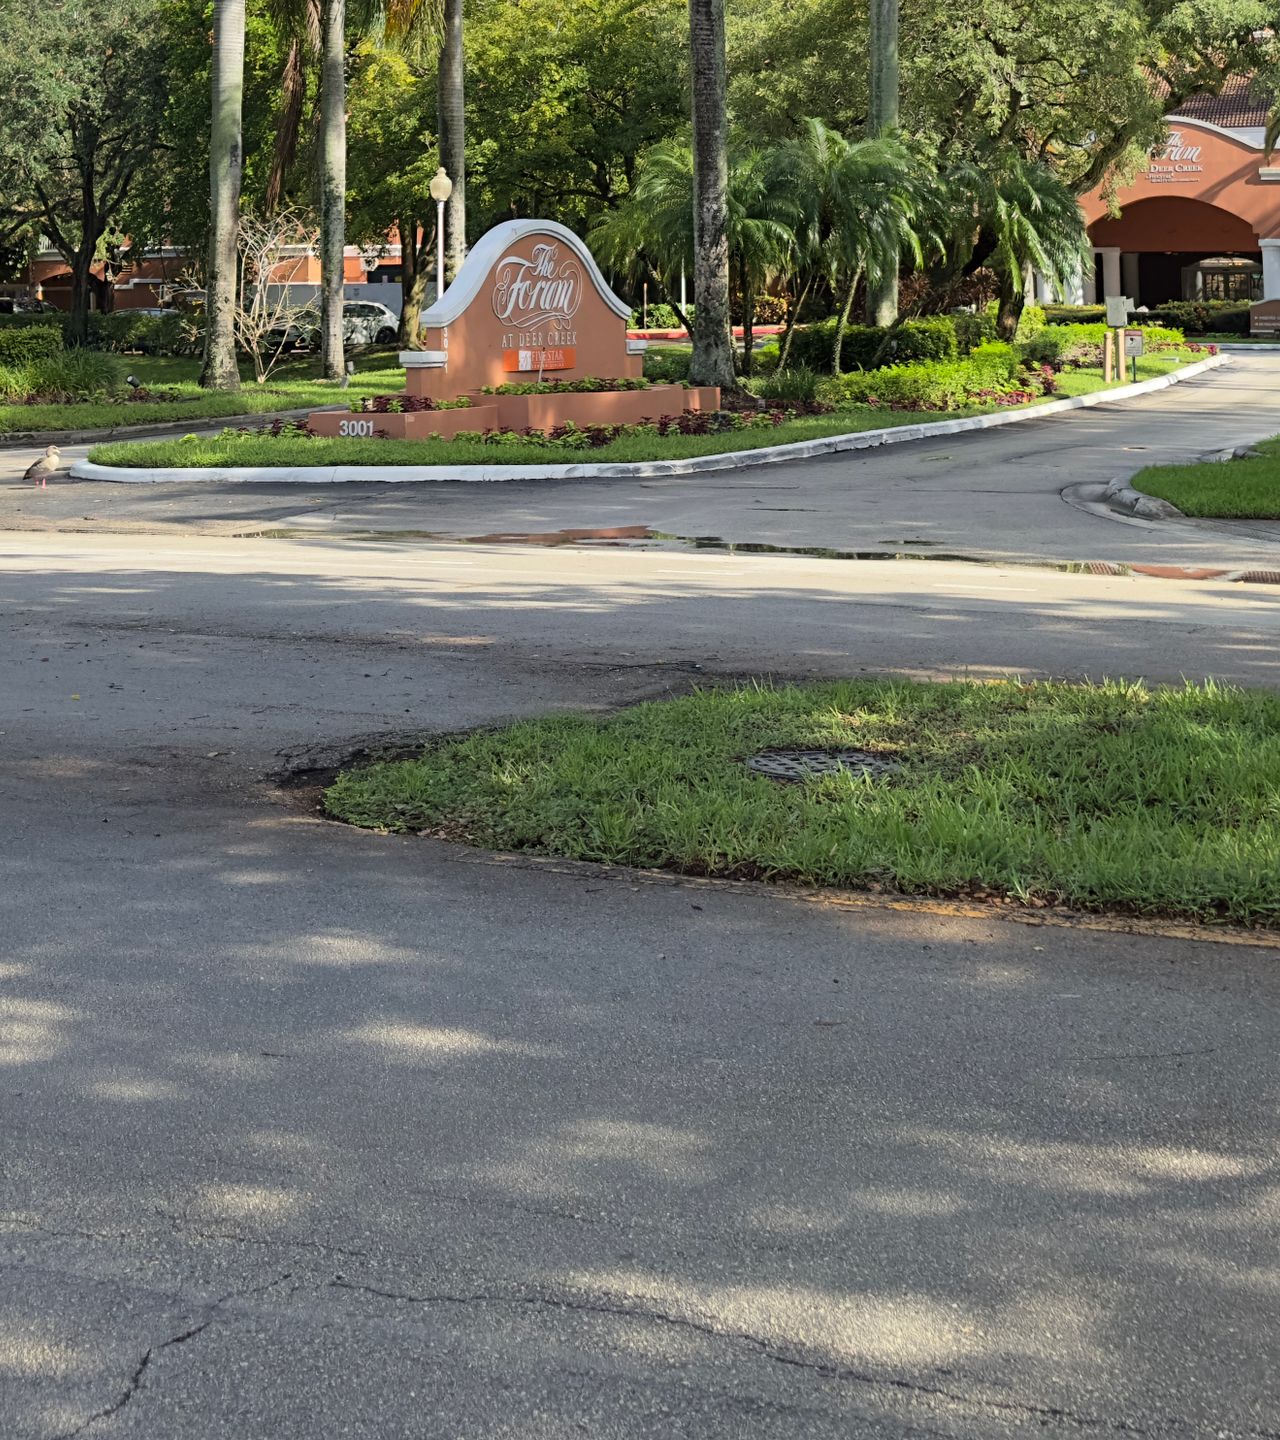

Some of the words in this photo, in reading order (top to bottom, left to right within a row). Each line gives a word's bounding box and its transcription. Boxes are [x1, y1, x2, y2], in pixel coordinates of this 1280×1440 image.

[1150, 164, 1174, 173] DEER
[1175, 163, 1203, 173] CREEK
[532, 243, 559, 278] The
[493, 256, 582, 320] Forum
[501, 334, 514, 348] AT
[519, 332, 543, 347] DEER
[547, 331, 577, 346] CREEK
[548, 350, 564, 361] STAR
[339, 420, 374, 437] 3001
